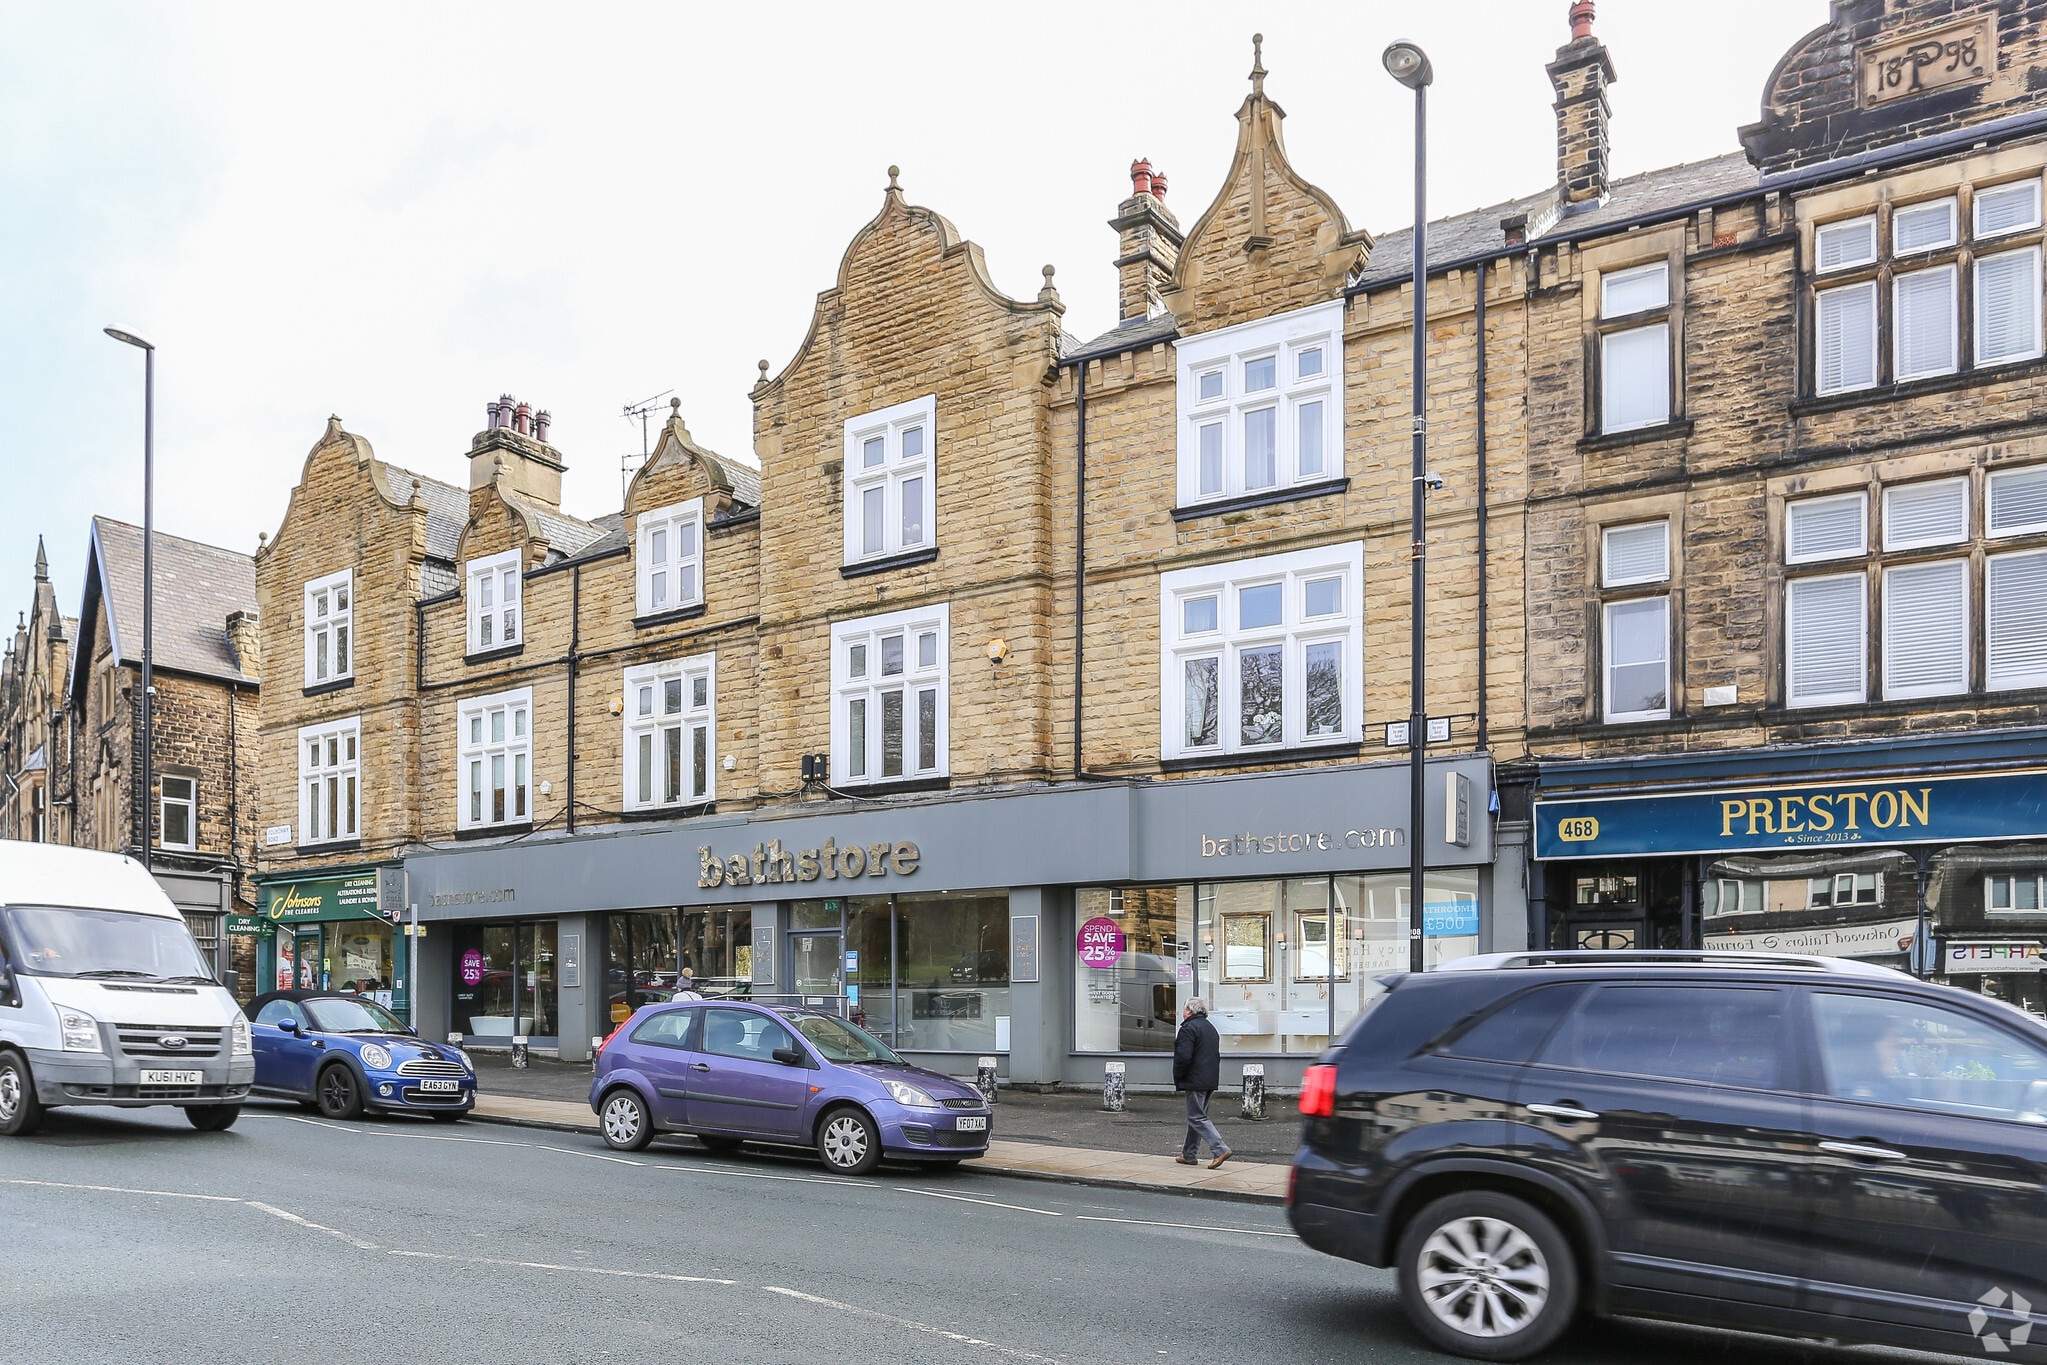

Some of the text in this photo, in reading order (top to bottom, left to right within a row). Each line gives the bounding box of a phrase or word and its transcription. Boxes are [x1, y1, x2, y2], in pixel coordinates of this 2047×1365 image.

[1719, 788, 1933, 837] PRESTON
[1563, 820, 1593, 839] 468
[1200, 827, 1406, 858] bathstore.com
[1796, 831, 1849, 844] Since 2013
[697, 835, 920, 888] bathstore
[270, 884, 323, 919] Johnsons
[295, 907, 319, 915] CLEANERS
[1084, 925, 1113, 933] SPEND
[1426, 916, 1465, 931] £500
[1083, 932, 1116, 943] SAVE
[1083, 945, 1116, 961] 25%
[464, 959, 480, 968] SAVE
[463, 968, 480, 980] 25%
[148, 1071, 196, 1082] KU61 HYC
[423, 1080, 457, 1090] EA63 GYN
[958, 1118, 985, 1129] YF07 XAC
